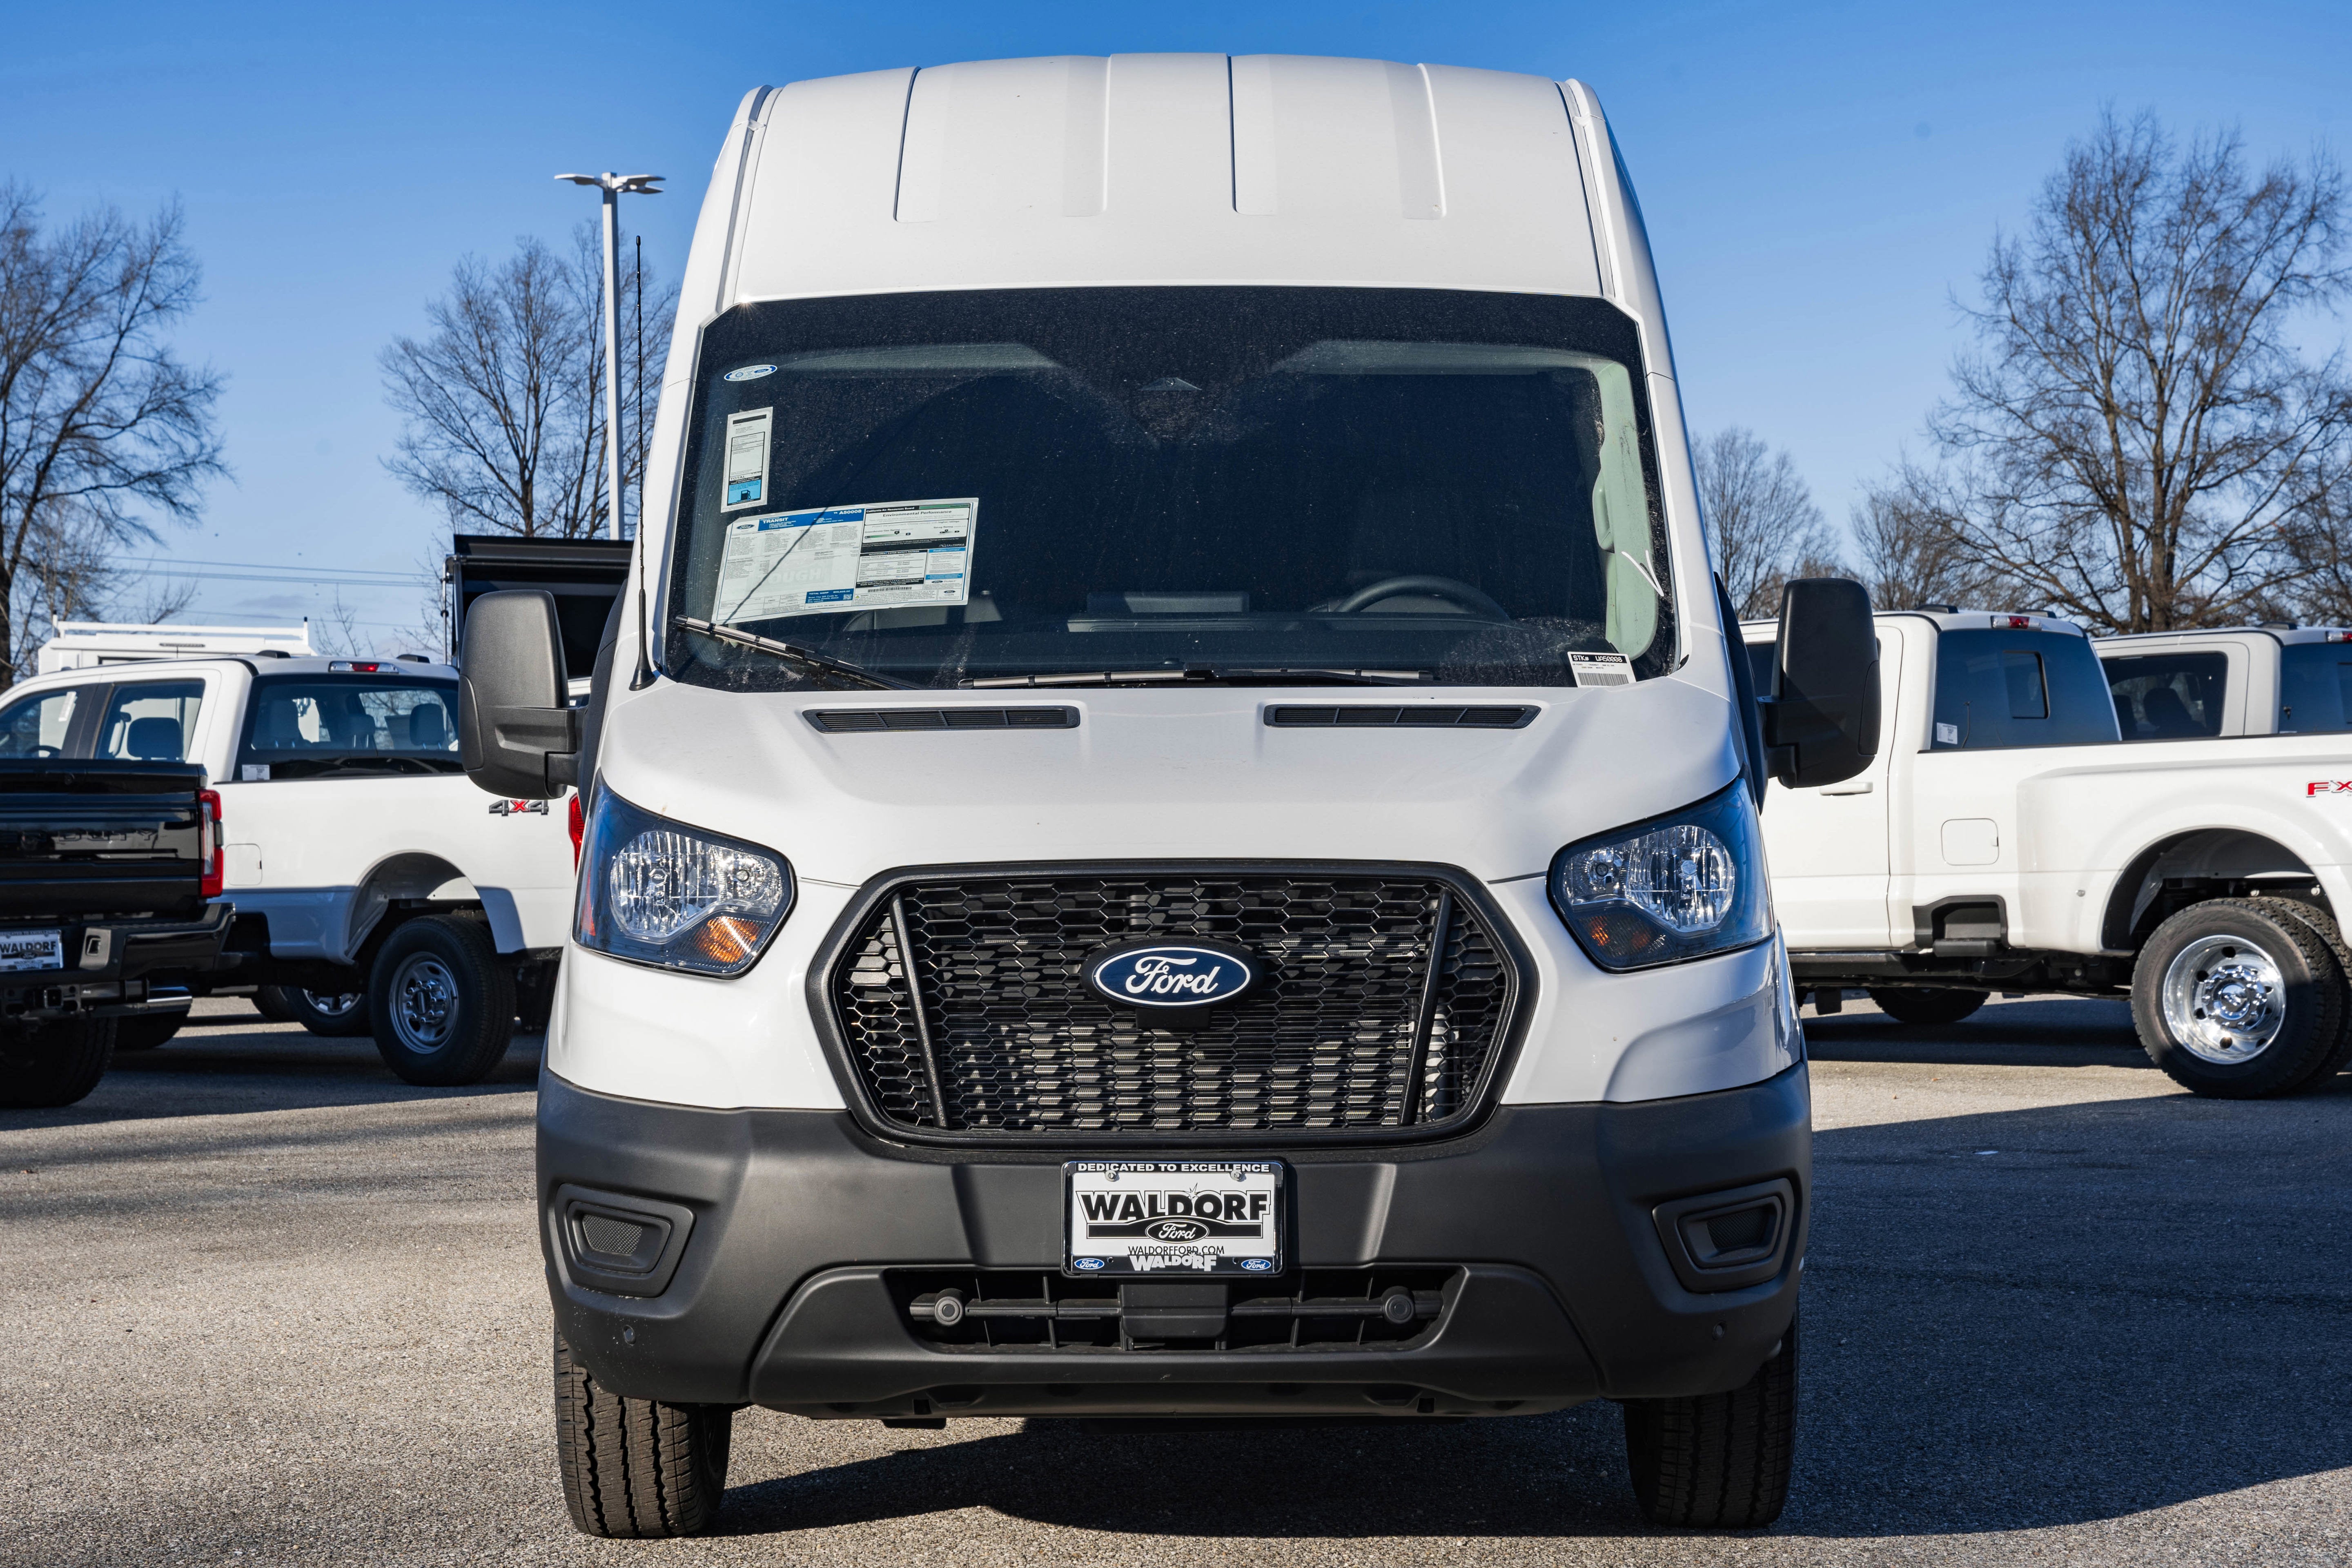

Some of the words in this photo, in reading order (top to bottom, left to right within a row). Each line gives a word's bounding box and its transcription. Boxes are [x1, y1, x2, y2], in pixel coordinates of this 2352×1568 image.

[0, 941, 56, 953] WALDORF
[1126, 956, 1221, 994] Ford
[1078, 1163, 1155, 1172] DEDICATED
[1158, 1163, 1177, 1172] TO
[1181, 1163, 1270, 1172] EXCELLENCE
[1080, 1192, 1269, 1221] WALDORF
[1158, 1222, 1195, 1240] Ford
[1128, 1245, 1225, 1255] WALDORFFORD.COM
[1078, 1259, 1100, 1269] Ford
[1129, 1252, 1217, 1272] WALDORF
[1245, 1259, 1267, 1269] Ford
